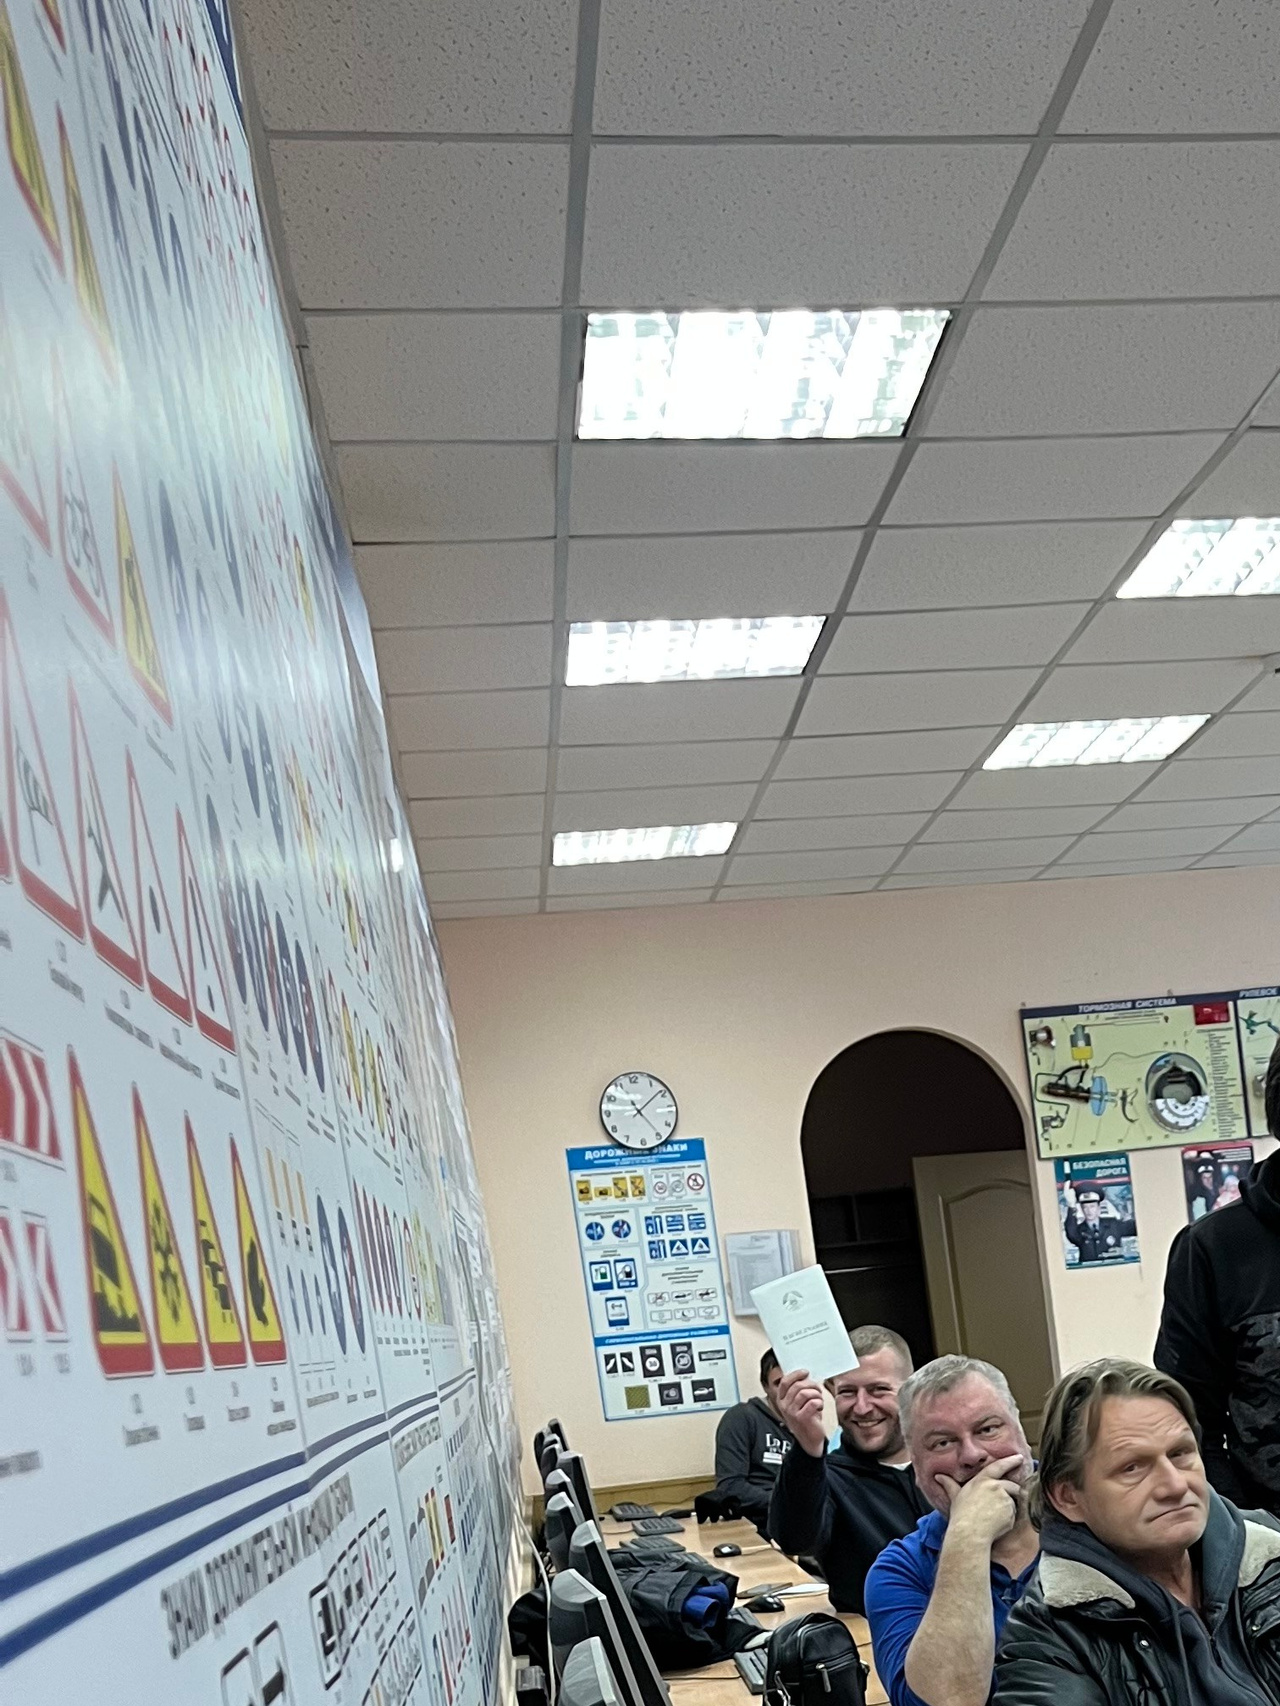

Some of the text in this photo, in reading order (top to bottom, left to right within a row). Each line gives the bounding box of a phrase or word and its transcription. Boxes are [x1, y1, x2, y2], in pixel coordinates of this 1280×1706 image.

[1078, 998, 1177, 1013] ТОРМОЗНАЯ СИСТЕМА
[628, 1075, 639, 1084] 12
[604, 1109, 611, 1118] 9
[664, 1120, 672, 1128] 4
[611, 1125, 618, 1133] 8
[624, 1134, 631, 1143] 7
[655, 1132, 663, 1141] 5
[640, 1137, 647, 1146] 6
[1072, 1158, 1127, 1170] БЕЗОПАСНАЯ
[1095, 1167, 1128, 1178] ДОРОГА
